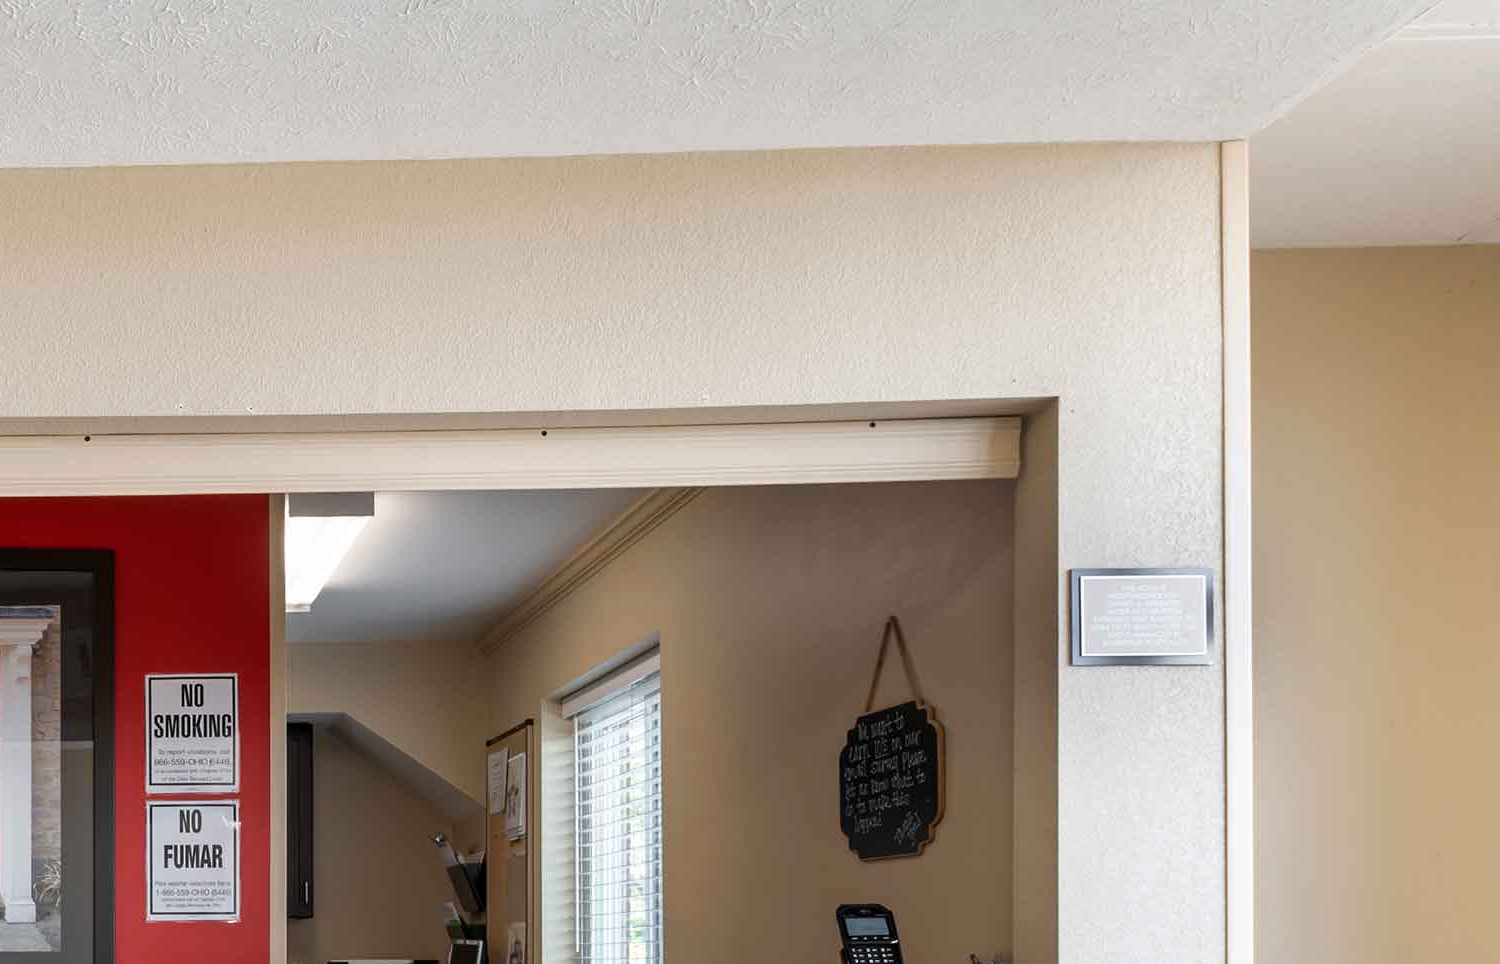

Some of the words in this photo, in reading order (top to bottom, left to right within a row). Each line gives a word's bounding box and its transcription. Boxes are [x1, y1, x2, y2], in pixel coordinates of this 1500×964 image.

[181, 683, 204, 707] NO
[154, 714, 232, 738] SMOKING
[180, 809, 202, 834] NO
[164, 844, 223, 869] FUMAR
